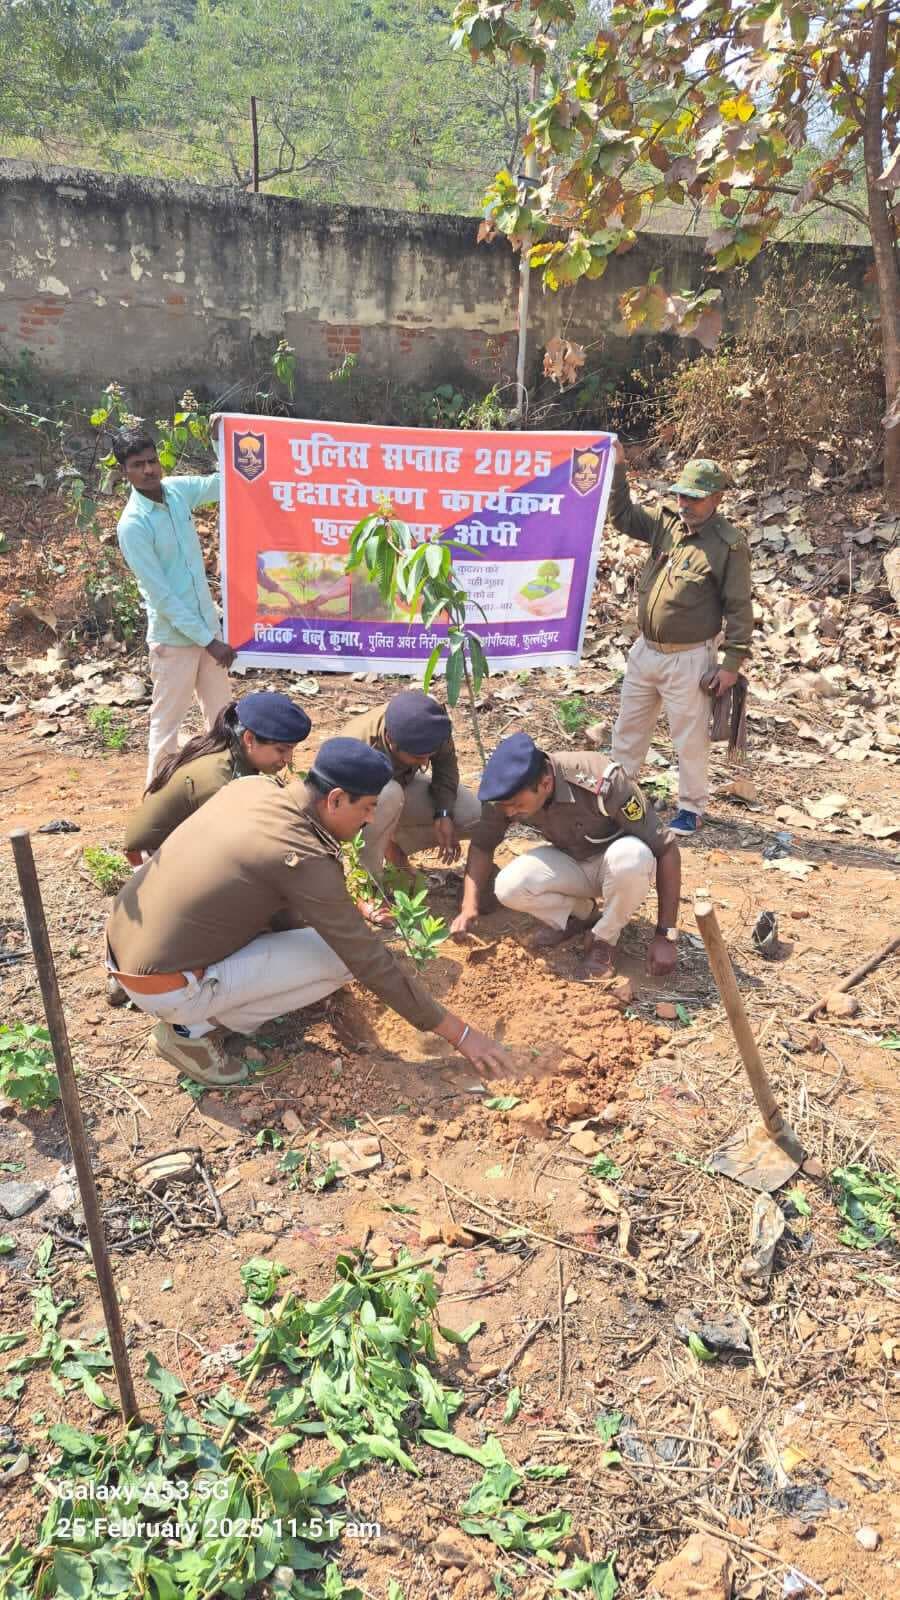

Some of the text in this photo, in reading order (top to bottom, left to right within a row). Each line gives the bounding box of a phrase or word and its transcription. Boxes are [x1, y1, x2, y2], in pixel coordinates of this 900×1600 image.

[288, 432, 553, 478] पुलिस सप्ताह 2025
[440, 485, 565, 516] कार्यक्रम
[453, 519, 522, 547] ओपी
[328, 630, 364, 651] कुमार,
[368, 632, 395, 653] पुलिस
[396, 634, 416, 649] अवर
